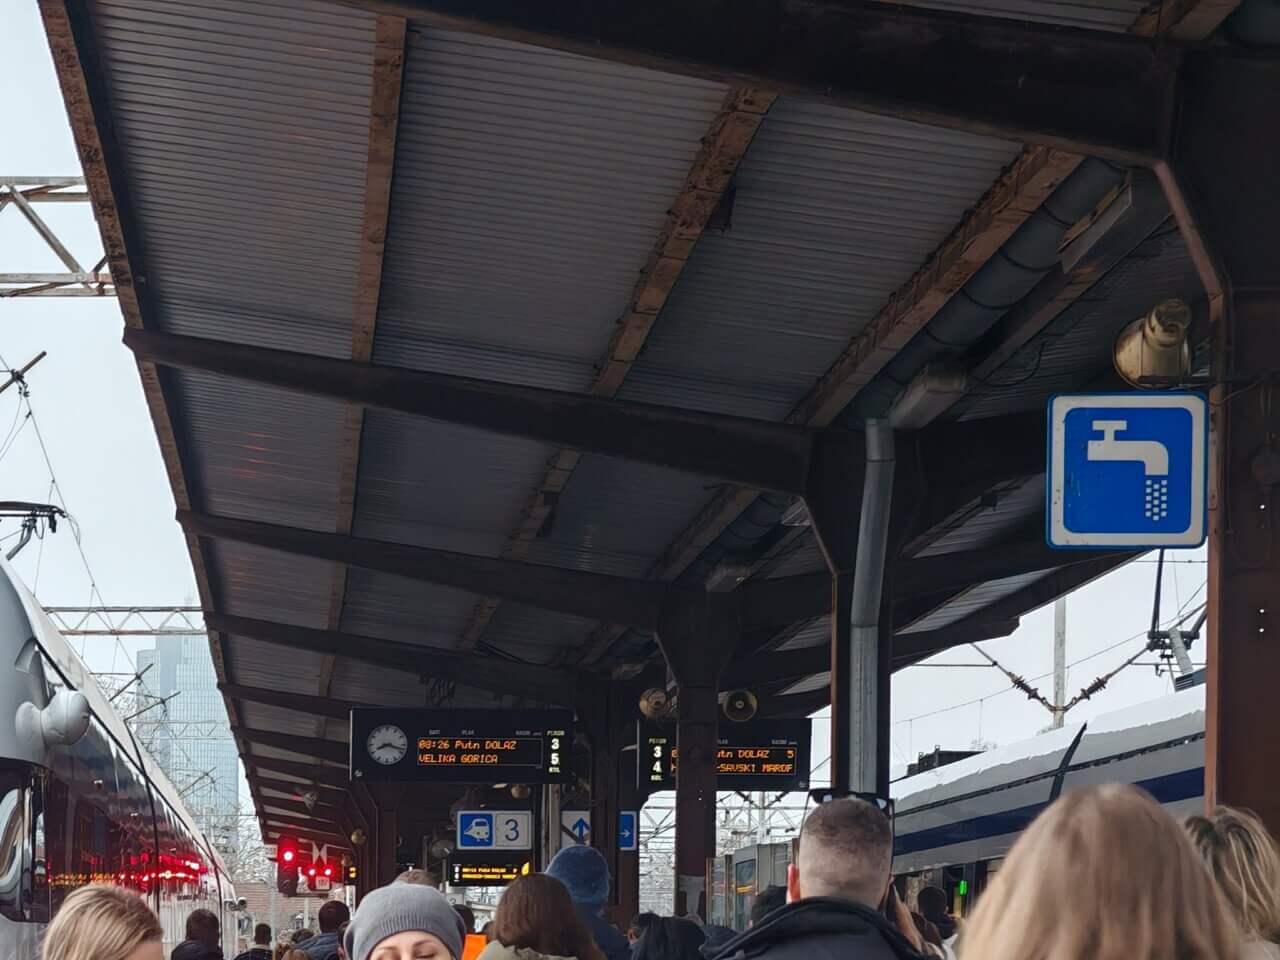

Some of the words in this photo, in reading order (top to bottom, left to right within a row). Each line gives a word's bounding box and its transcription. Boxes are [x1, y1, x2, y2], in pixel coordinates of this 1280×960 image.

[485, 740, 517, 750] DOLAZ
[551, 738, 560, 751] 3
[653, 745, 662, 758] 3
[738, 750, 769, 759] DOLAZ
[419, 754, 455, 764] VELIKA
[461, 754, 498, 764] GORICA
[551, 753, 560, 765] 5
[652, 761, 662, 773] 4
[762, 763, 793, 773] MAROF
[504, 819, 520, 842] 3
